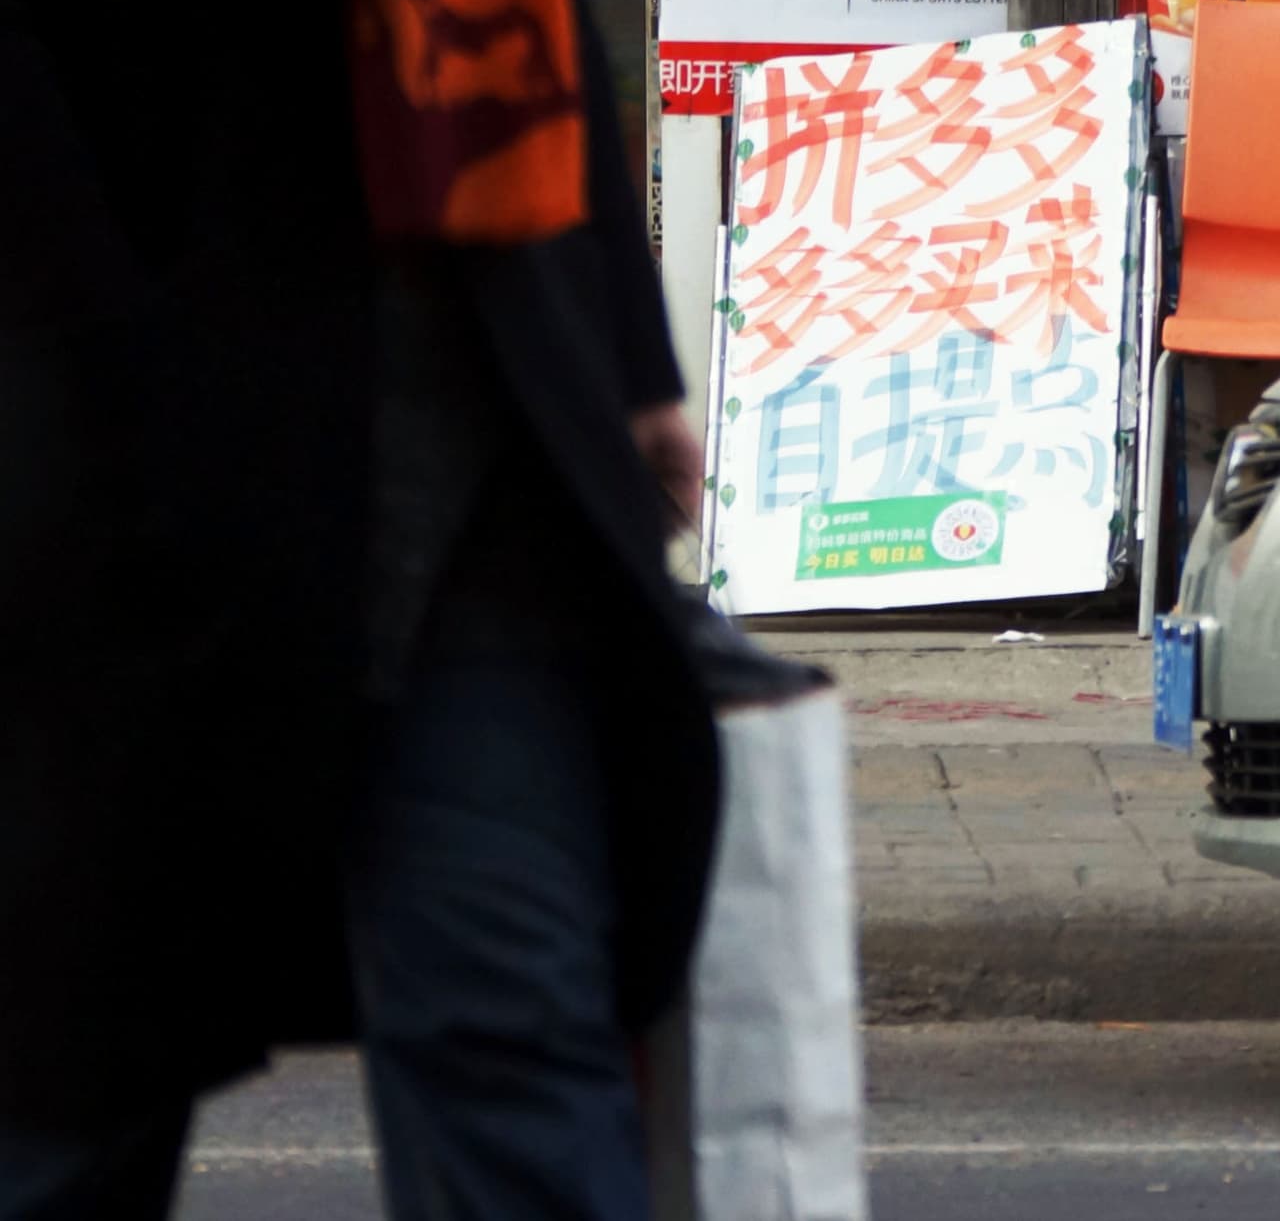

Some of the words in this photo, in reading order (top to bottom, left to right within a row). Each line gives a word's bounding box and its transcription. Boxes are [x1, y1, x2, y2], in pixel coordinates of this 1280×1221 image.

[740, 24, 1104, 235] 拼多多
[733, 183, 1113, 380] 多多买菜
[748, 313, 1110, 516] 自提点
